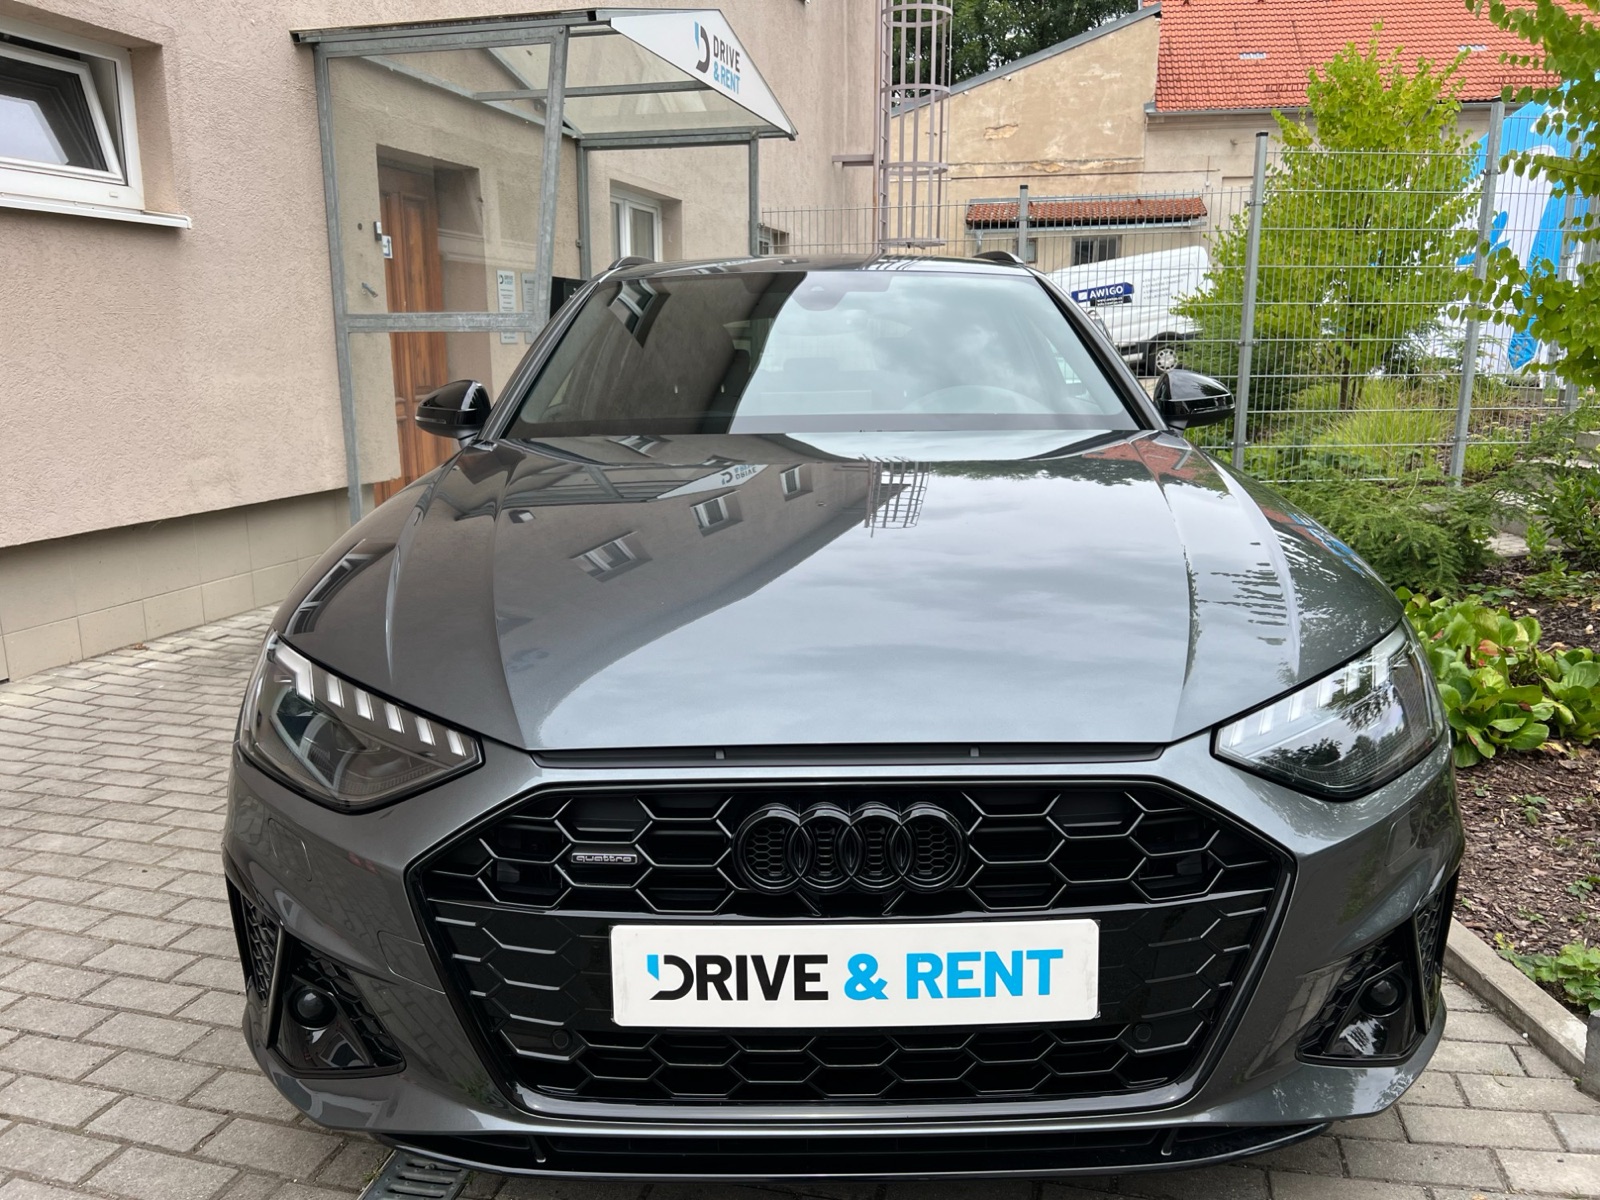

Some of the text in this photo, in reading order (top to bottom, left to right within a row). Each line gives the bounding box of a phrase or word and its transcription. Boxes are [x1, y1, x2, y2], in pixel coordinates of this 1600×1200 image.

[713, 35, 741, 73] DRIVE
[713, 61, 741, 95] & RENT
[1089, 286, 1124, 299] AWIGO
[576, 855, 632, 863] quattro
[646, 948, 1064, 1001] DRIVE & RENT
